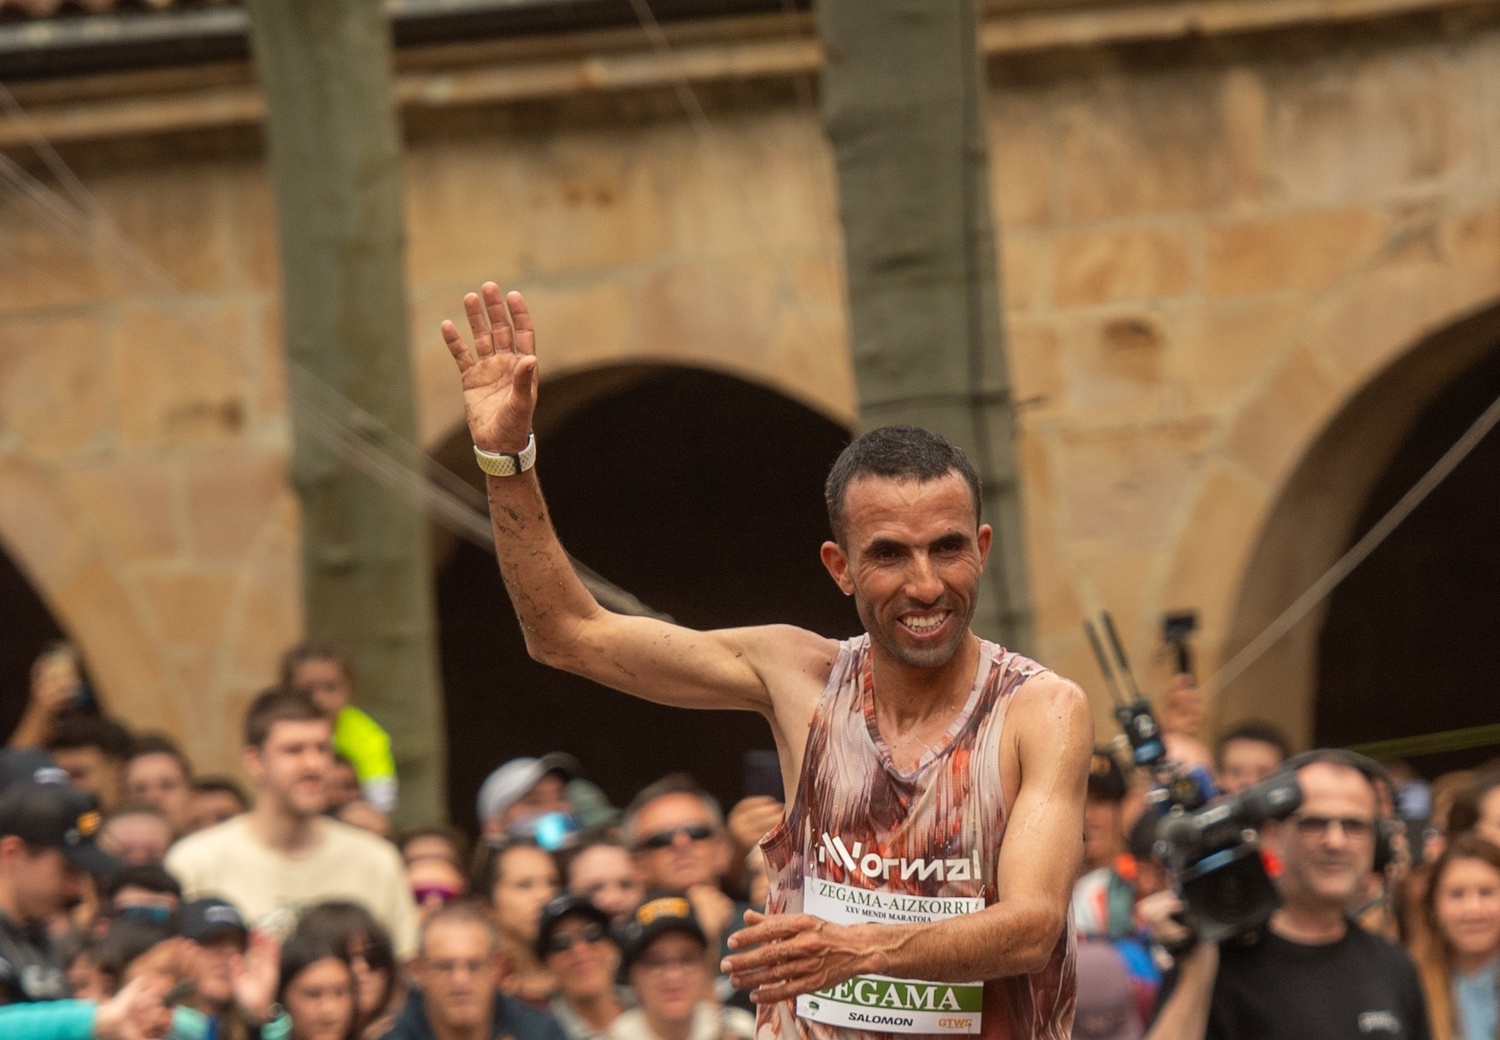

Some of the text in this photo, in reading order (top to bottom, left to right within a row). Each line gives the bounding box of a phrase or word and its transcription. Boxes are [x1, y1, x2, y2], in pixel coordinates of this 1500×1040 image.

[819, 883, 970, 914] ZEGAMA-AIZKORRI
[845, 905, 932, 922] XXV MENDI MARATOIA
[848, 1012, 914, 1027] SALOMON
[938, 1018, 973, 1028] GTWS
